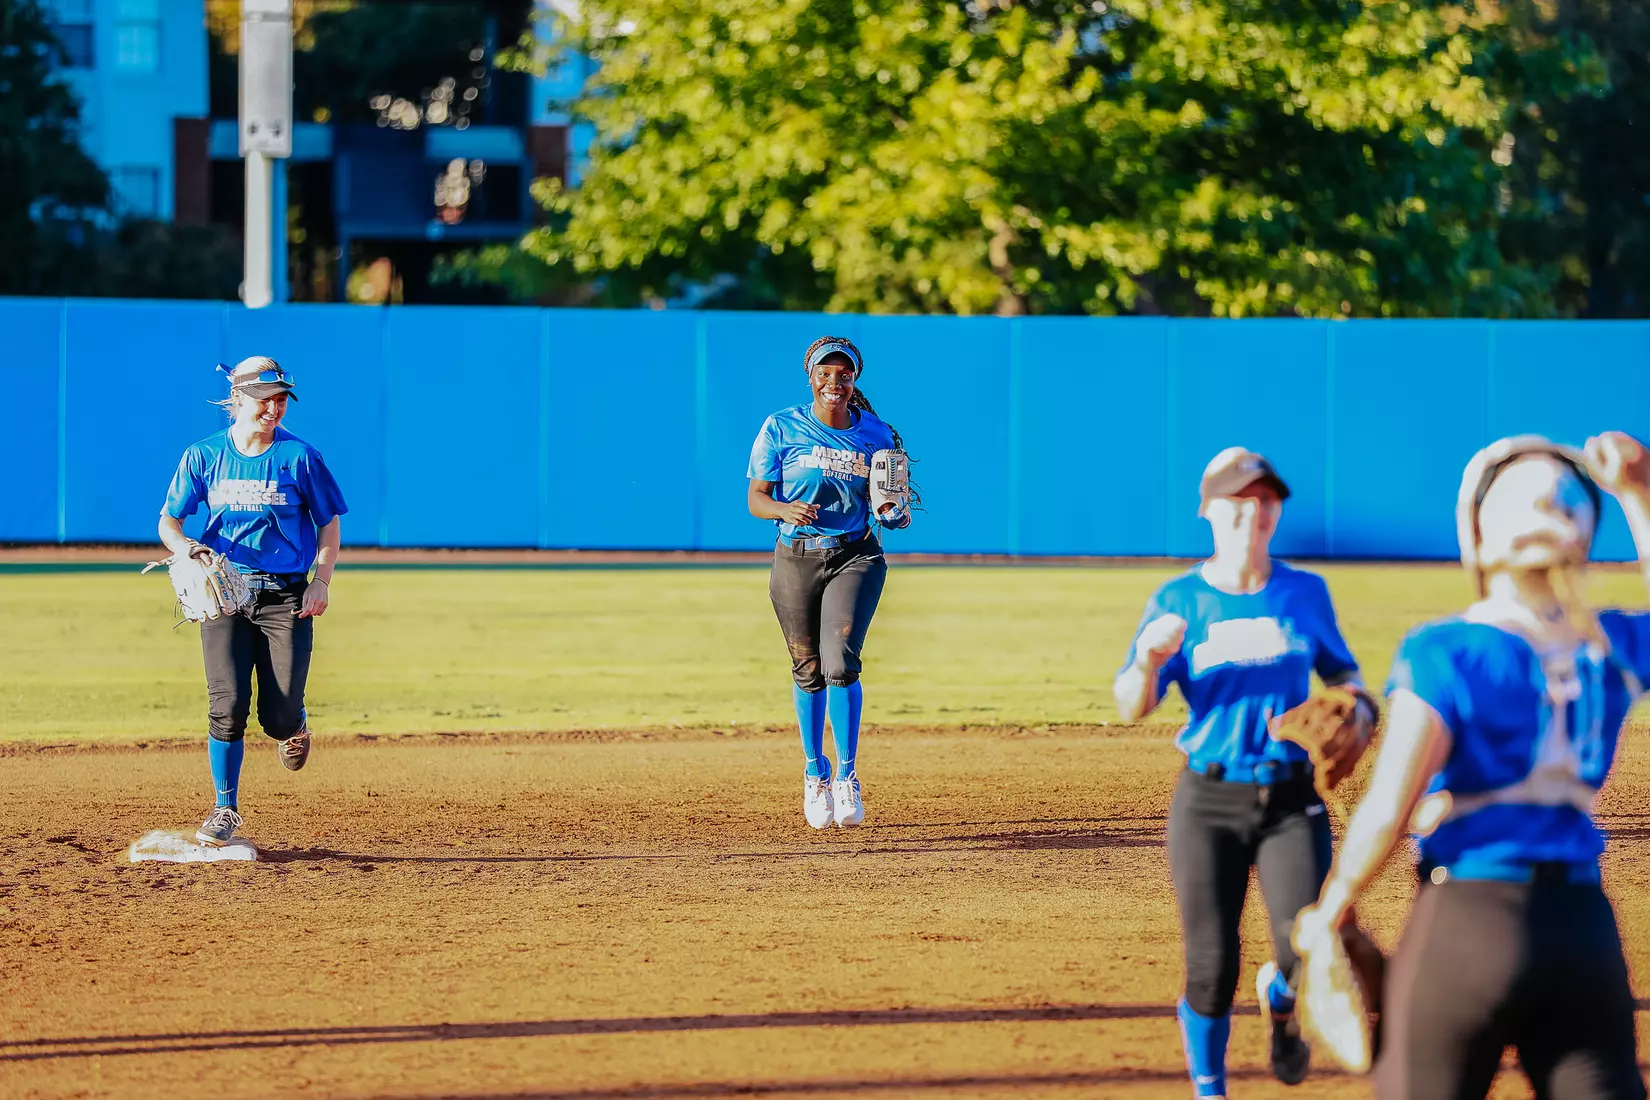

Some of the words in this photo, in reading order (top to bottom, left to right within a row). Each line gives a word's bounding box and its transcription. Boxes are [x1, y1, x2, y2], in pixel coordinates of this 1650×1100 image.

[811, 445, 865, 466] MIDDLE
[799, 454, 870, 478] TENNESSE
[822, 469, 853, 481] SOFTBALL
[229, 504, 264, 512] SOFTBALL
